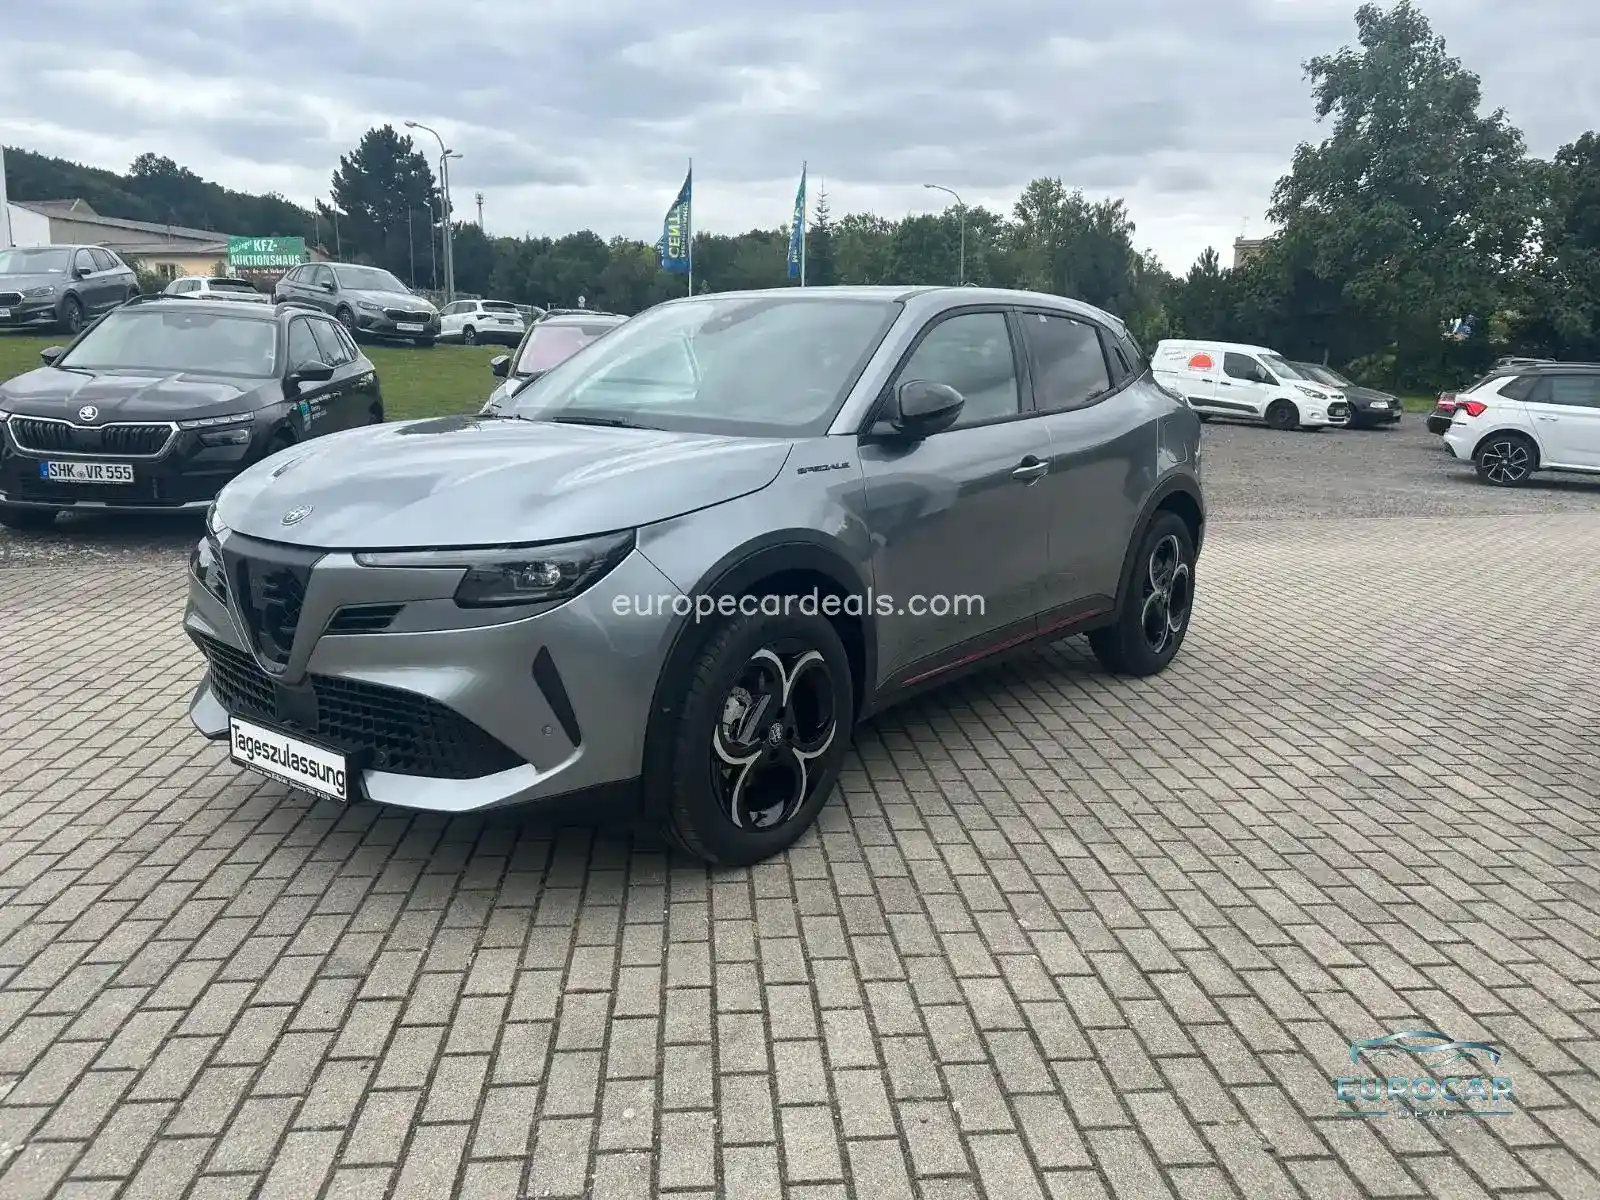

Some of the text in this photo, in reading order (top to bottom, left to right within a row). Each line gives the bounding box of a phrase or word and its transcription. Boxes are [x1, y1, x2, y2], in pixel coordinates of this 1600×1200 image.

[253, 240, 278, 252] KFZ-
[230, 254, 301, 266] AUKTIONSHAUS
[49, 463, 132, 480] SHK VR 555
[231, 723, 346, 797] Tageszulassung
